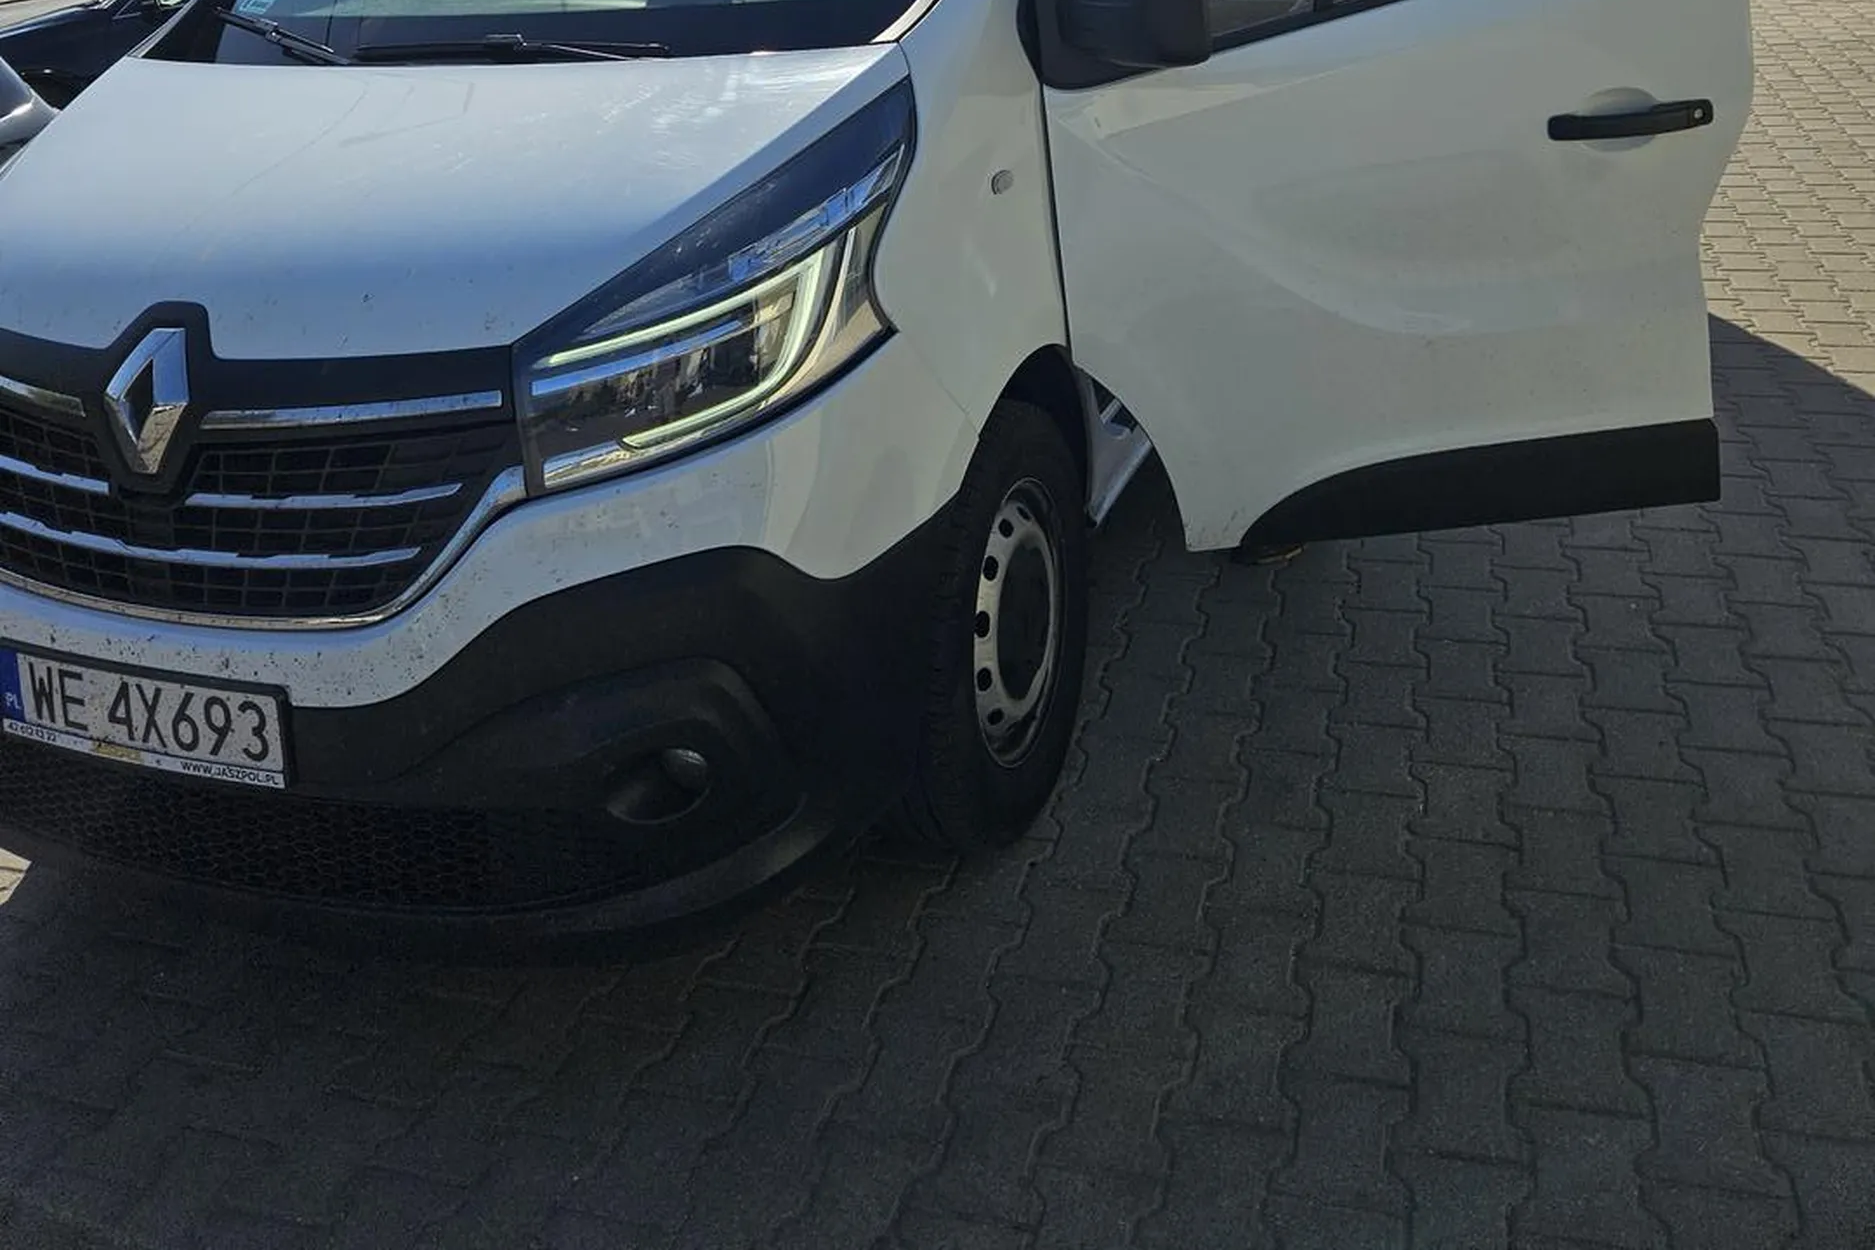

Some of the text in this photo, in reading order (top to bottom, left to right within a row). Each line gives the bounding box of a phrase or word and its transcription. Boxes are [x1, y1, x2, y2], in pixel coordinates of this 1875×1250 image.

[5, 691, 22, 710] PL
[28, 661, 270, 762] WE 4X693
